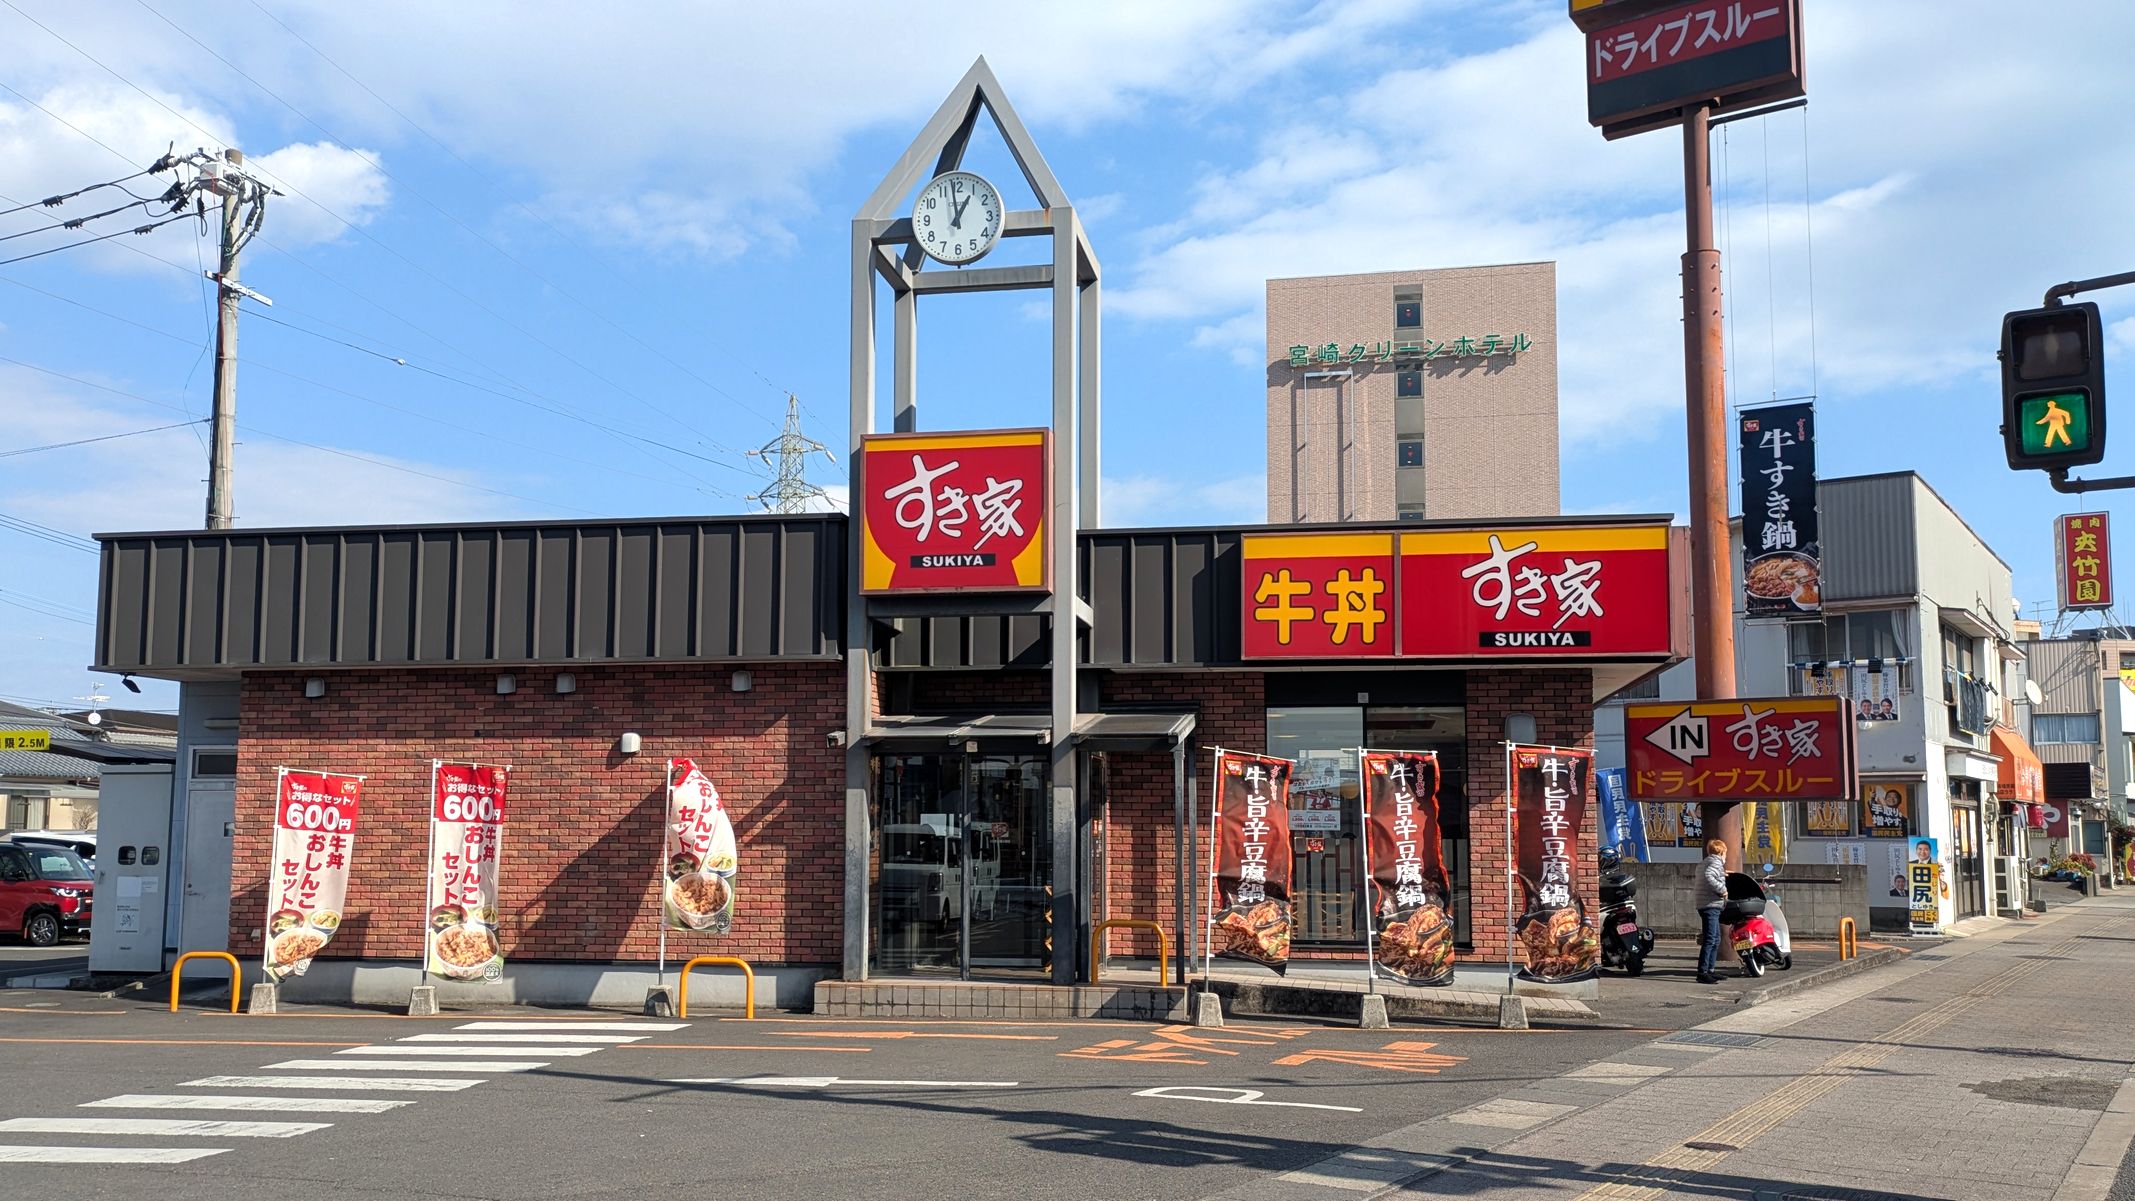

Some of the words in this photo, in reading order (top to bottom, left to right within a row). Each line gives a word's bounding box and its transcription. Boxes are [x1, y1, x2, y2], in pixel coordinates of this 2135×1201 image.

[1594, 2, 1780, 78] ドライブスルー
[926, 198, 936, 210] 10
[939, 186, 947, 198] 11
[971, 183, 975, 196] 1
[981, 194, 988, 206] 2
[923, 214, 931, 227] 9
[986, 210, 993, 222] 3
[927, 231, 935, 242] 8
[940, 241, 947, 253] 7
[969, 239, 977, 250] 5
[980, 227, 989, 239] 4
[954, 244, 962, 256] 6
[1288, 332, 1533, 368] 宮崎グリーンホテル
[884, 454, 1025, 551] すき家
[1758, 428, 1797, 551] 牛すき鍋
[922, 555, 984, 568] SUKIYA
[1460, 534, 1605, 630] すき家
[1254, 568, 1386, 645] 牛丼
[1494, 632, 1576, 647] SUKIYA
[18, 736, 45, 748] 2.5M
[1669, 724, 1704, 750] IN
[1724, 704, 1822, 766] すき家
[447, 782, 502, 796] お得なセット
[1635, 767, 1834, 795] ドライブスルー
[291, 790, 352, 806] お得なセット
[443, 794, 503, 821] 600円
[286, 802, 352, 831] 600円
[678, 805, 696, 853] セット
[694, 781, 713, 853] おしんこ
[483, 826, 497, 863] 牛丼
[1237, 765, 1271, 904] 牛・旨辛豆腐鍋
[1389, 763, 1426, 907] 牛・旨辛豆腐鍋
[1540, 758, 1570, 907] 牛・旨辛豆腐鍋
[326, 835, 347, 870] 牛丼
[461, 826, 484, 905] おしんこ
[281, 858, 300, 910] セット
[298, 834, 327, 909] おしんこ
[442, 852, 460, 905] セット
[1912, 866, 1932, 903] 田尻
